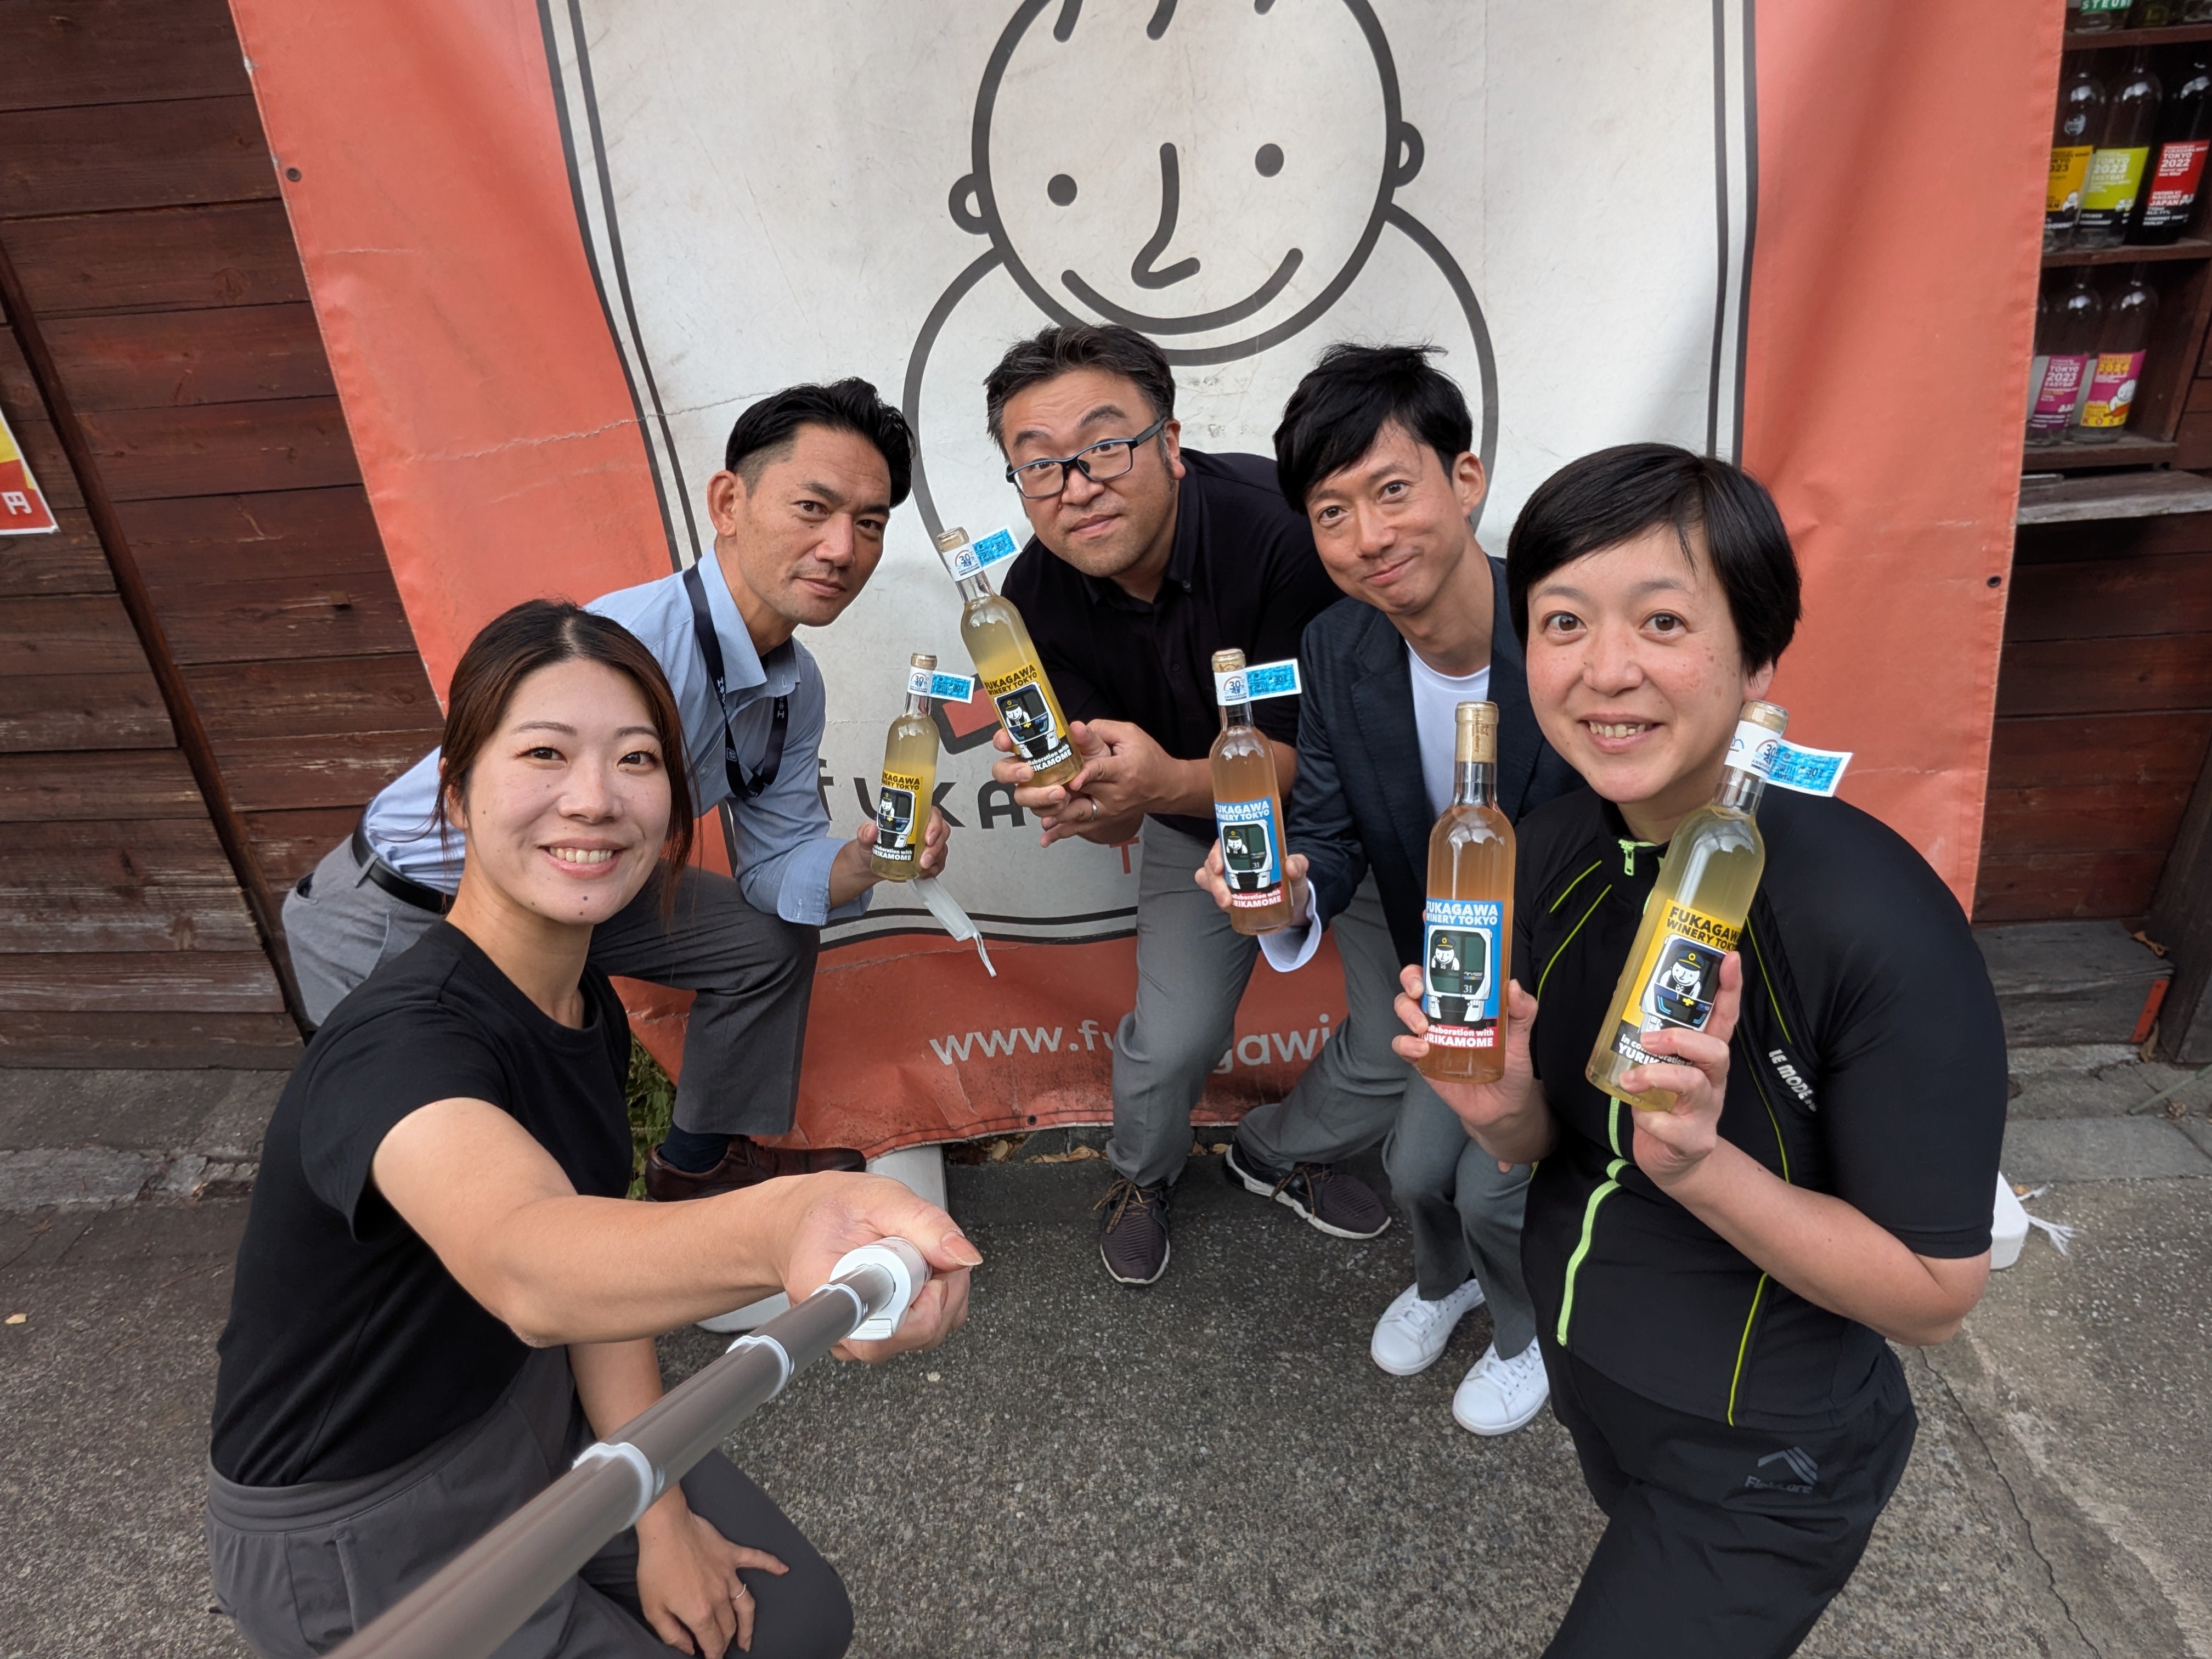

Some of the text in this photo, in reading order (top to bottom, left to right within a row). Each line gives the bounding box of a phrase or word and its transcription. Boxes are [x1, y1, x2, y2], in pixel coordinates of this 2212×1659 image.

[2049, 164, 2069, 172] 023
[2161, 159, 2191, 167] 2022
[2, 492, 32, 515] 円
[959, 553, 972, 566] 30
[984, 664, 1035, 690] FUKAGAWA
[988, 672, 1037, 695] WINERY TOKYO
[1026, 743, 1070, 766] llaboration with
[1031, 748, 1072, 772] IKAMOME
[883, 771, 921, 785] KAGAWA
[1805, 767, 1819, 777] 30
[882, 778, 895, 787] NERY
[1215, 800, 1269, 814] FUKAGAWA
[1216, 809, 1270, 821] WINERY TOKYO
[872, 848, 912, 861] RIKAMOME
[873, 844, 900, 855] aboration
[1267, 888, 1281, 897] with
[1232, 895, 1282, 908] RIKAMOME
[1426, 901, 1499, 917] FUKAGAWA
[1426, 912, 1498, 926] WINERY TOKYO
[1669, 906, 1740, 943] FUKAGAW
[1667, 918, 1735, 951] WINERY TOK
[1463, 985, 1473, 993] 31
[1427, 1024, 1494, 1037] ollaboration with
[1424, 1033, 1493, 1048] URIKAMOME
